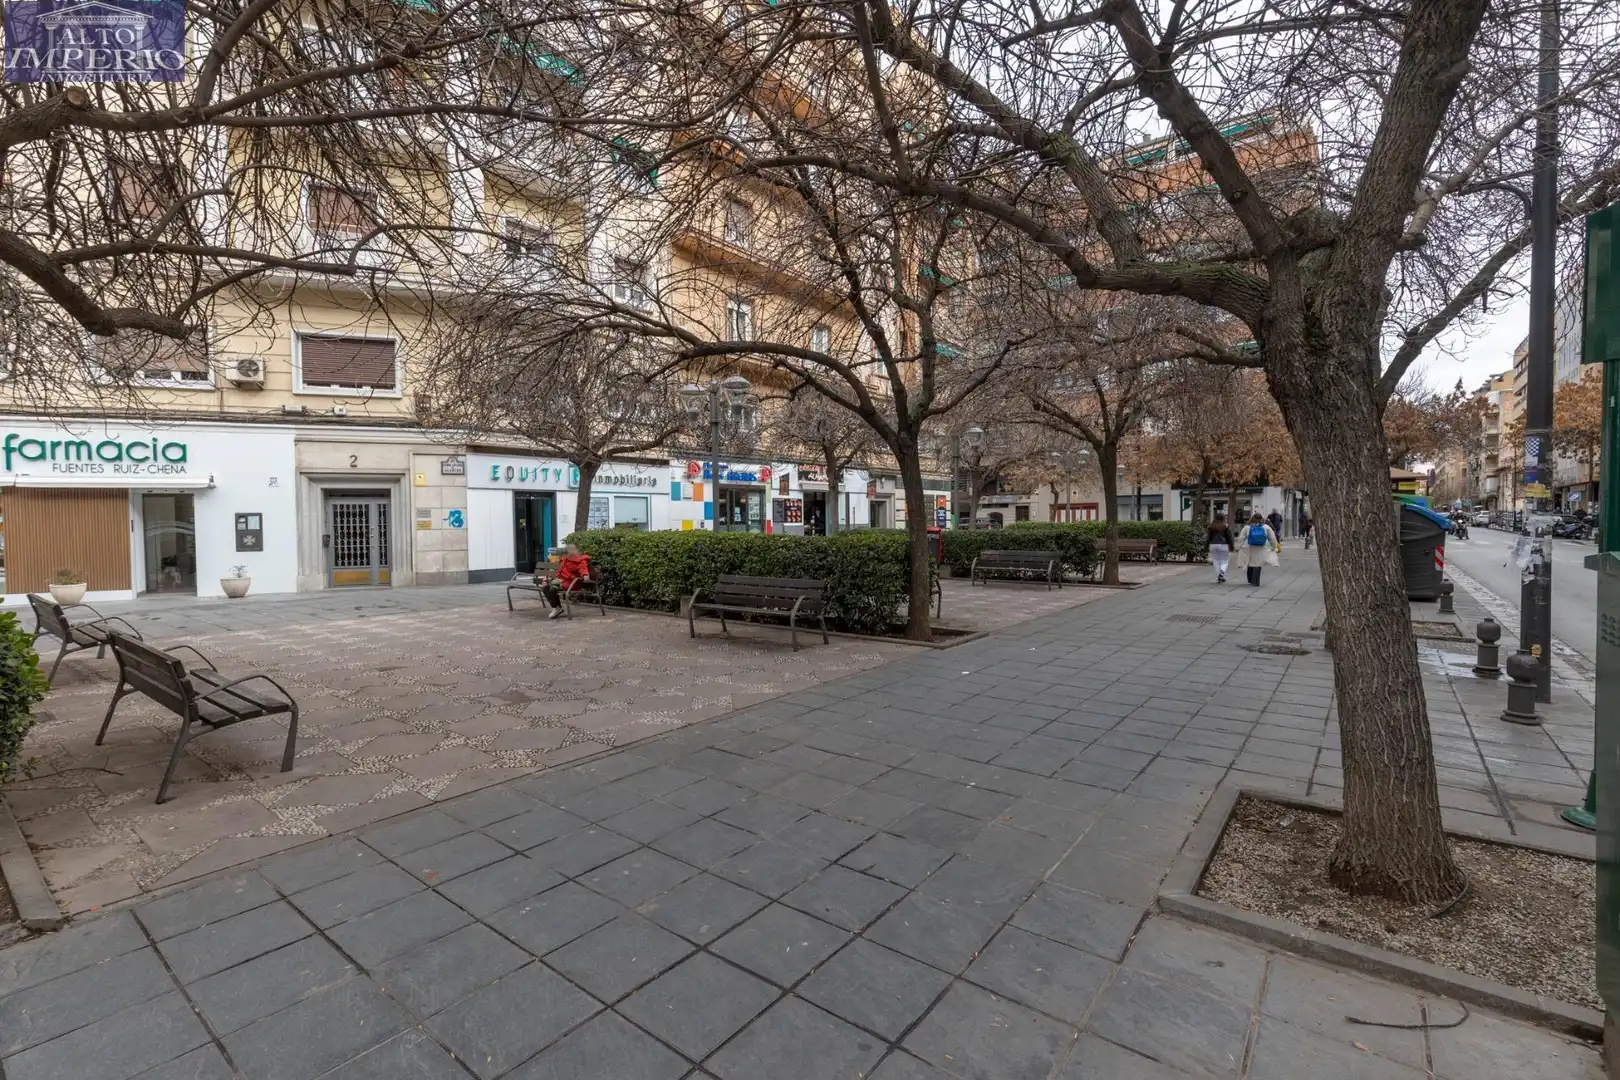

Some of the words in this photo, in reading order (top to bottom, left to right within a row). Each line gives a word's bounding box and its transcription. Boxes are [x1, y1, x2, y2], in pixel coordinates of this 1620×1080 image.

[2, 433, 188, 471] farmacia
[52, 462, 105, 474] FUENTES
[113, 463, 187, 475] RUIZ-CHENA
[349, 454, 358, 468] 2
[490, 464, 562, 483] EQUITY
[593, 473, 658, 489] inmobiliaria
